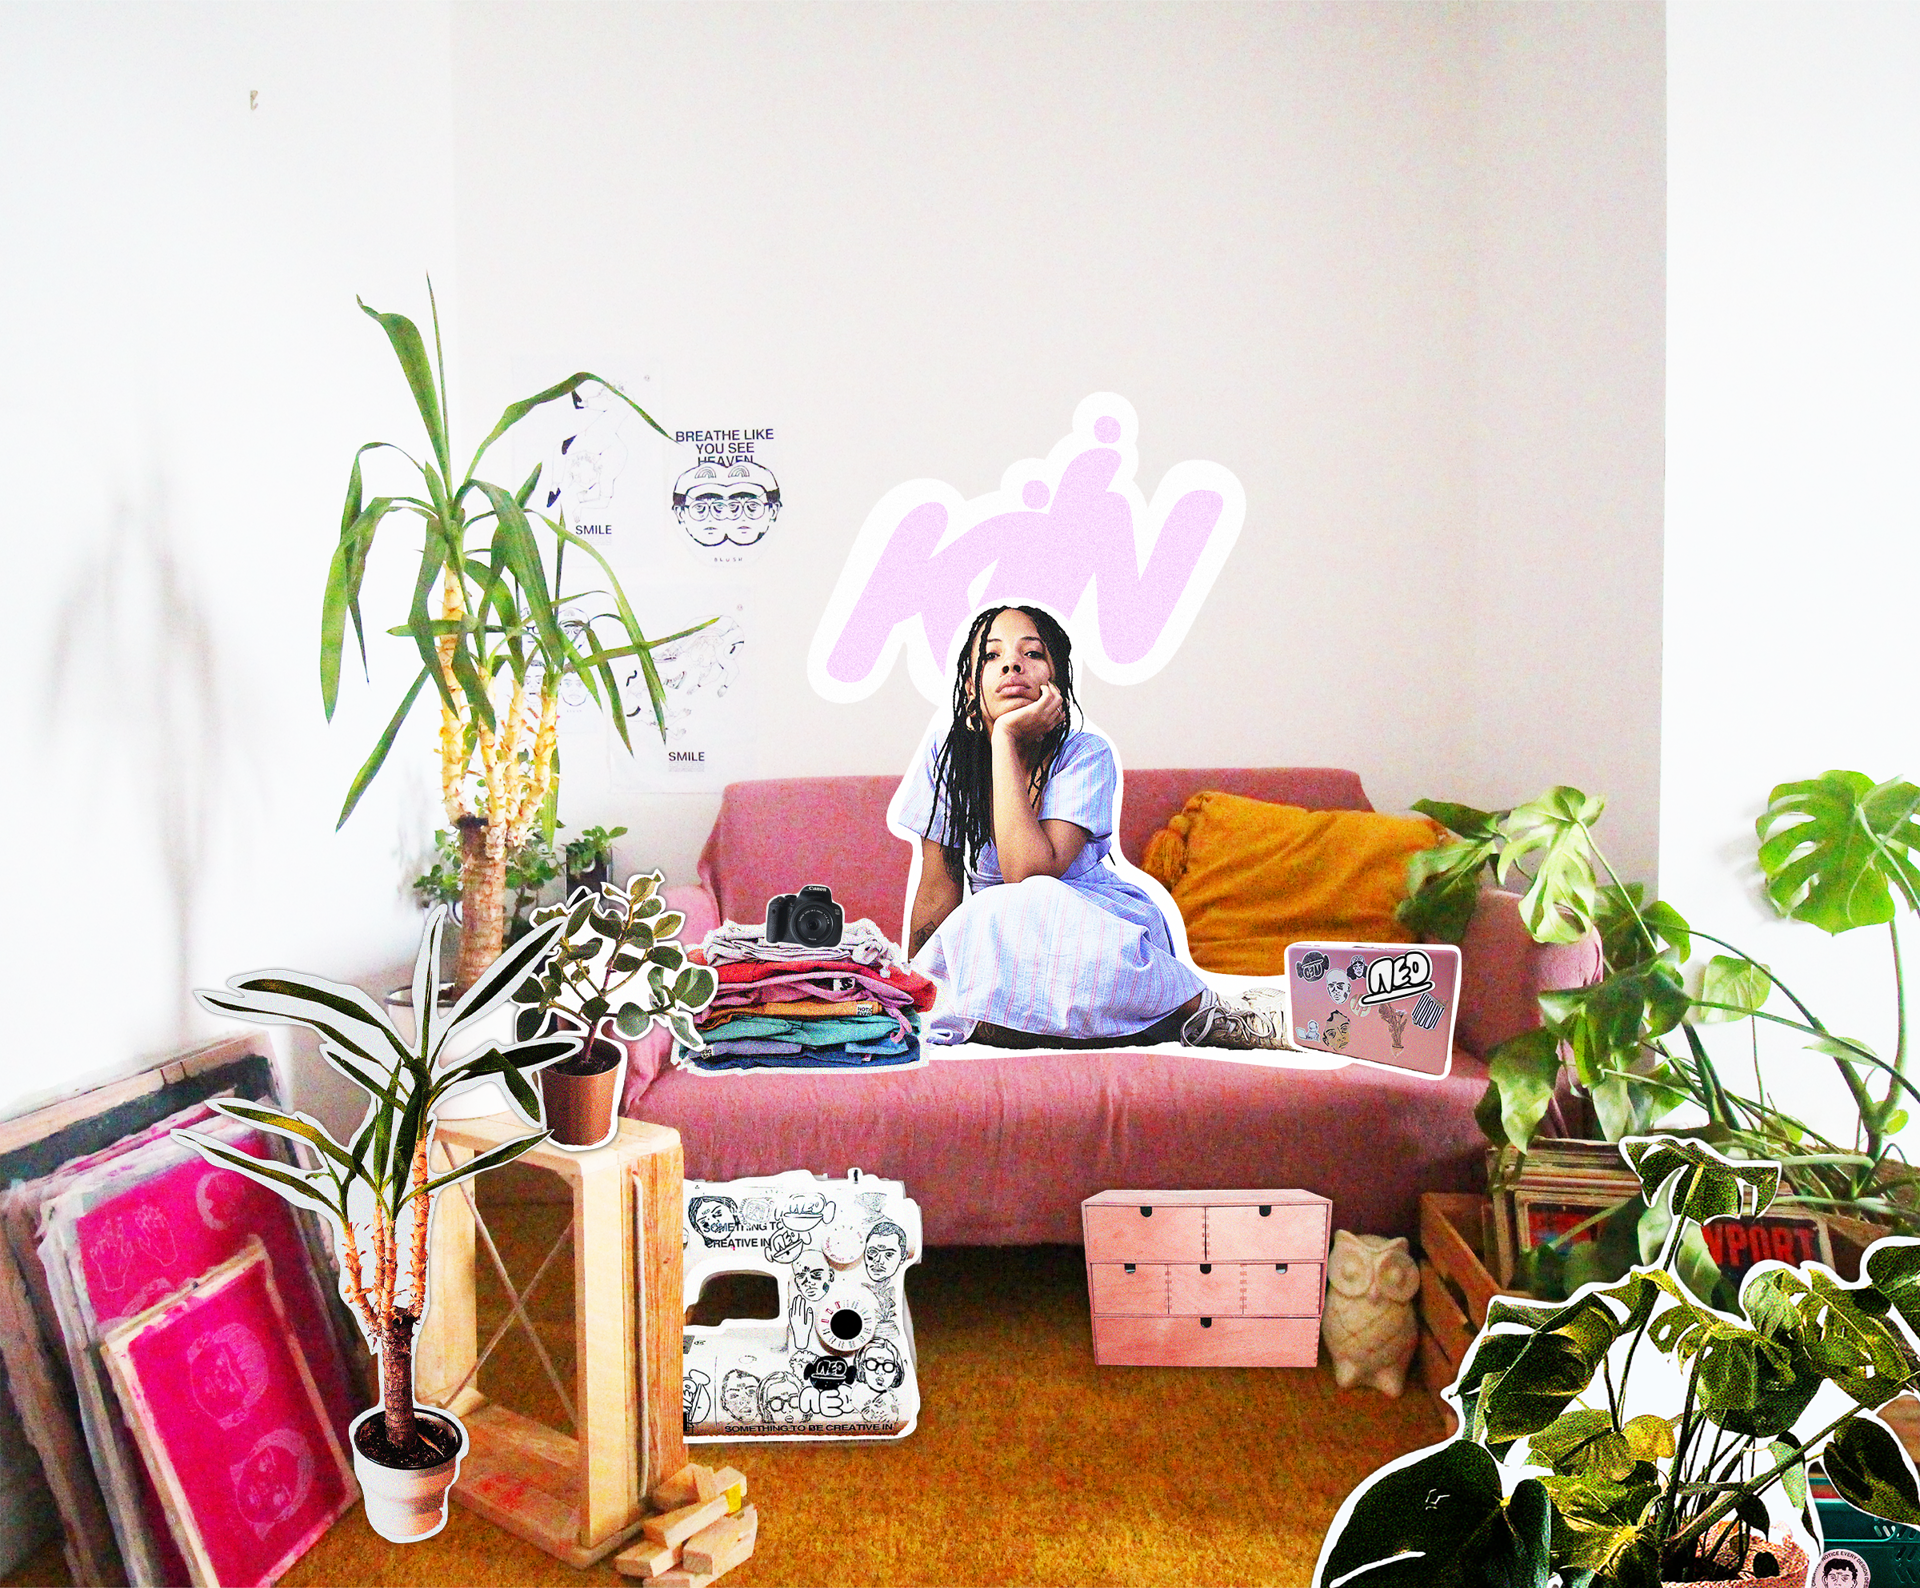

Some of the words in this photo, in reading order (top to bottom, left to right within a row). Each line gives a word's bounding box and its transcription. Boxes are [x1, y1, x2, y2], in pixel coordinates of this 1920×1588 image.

[675, 430, 740, 442] BREATHE
[744, 428, 774, 440] LIKE
[696, 443, 725, 455] YOU
[728, 442, 755, 454] SEE
[575, 524, 612, 535] SMILE
[668, 751, 705, 762] SMILE
